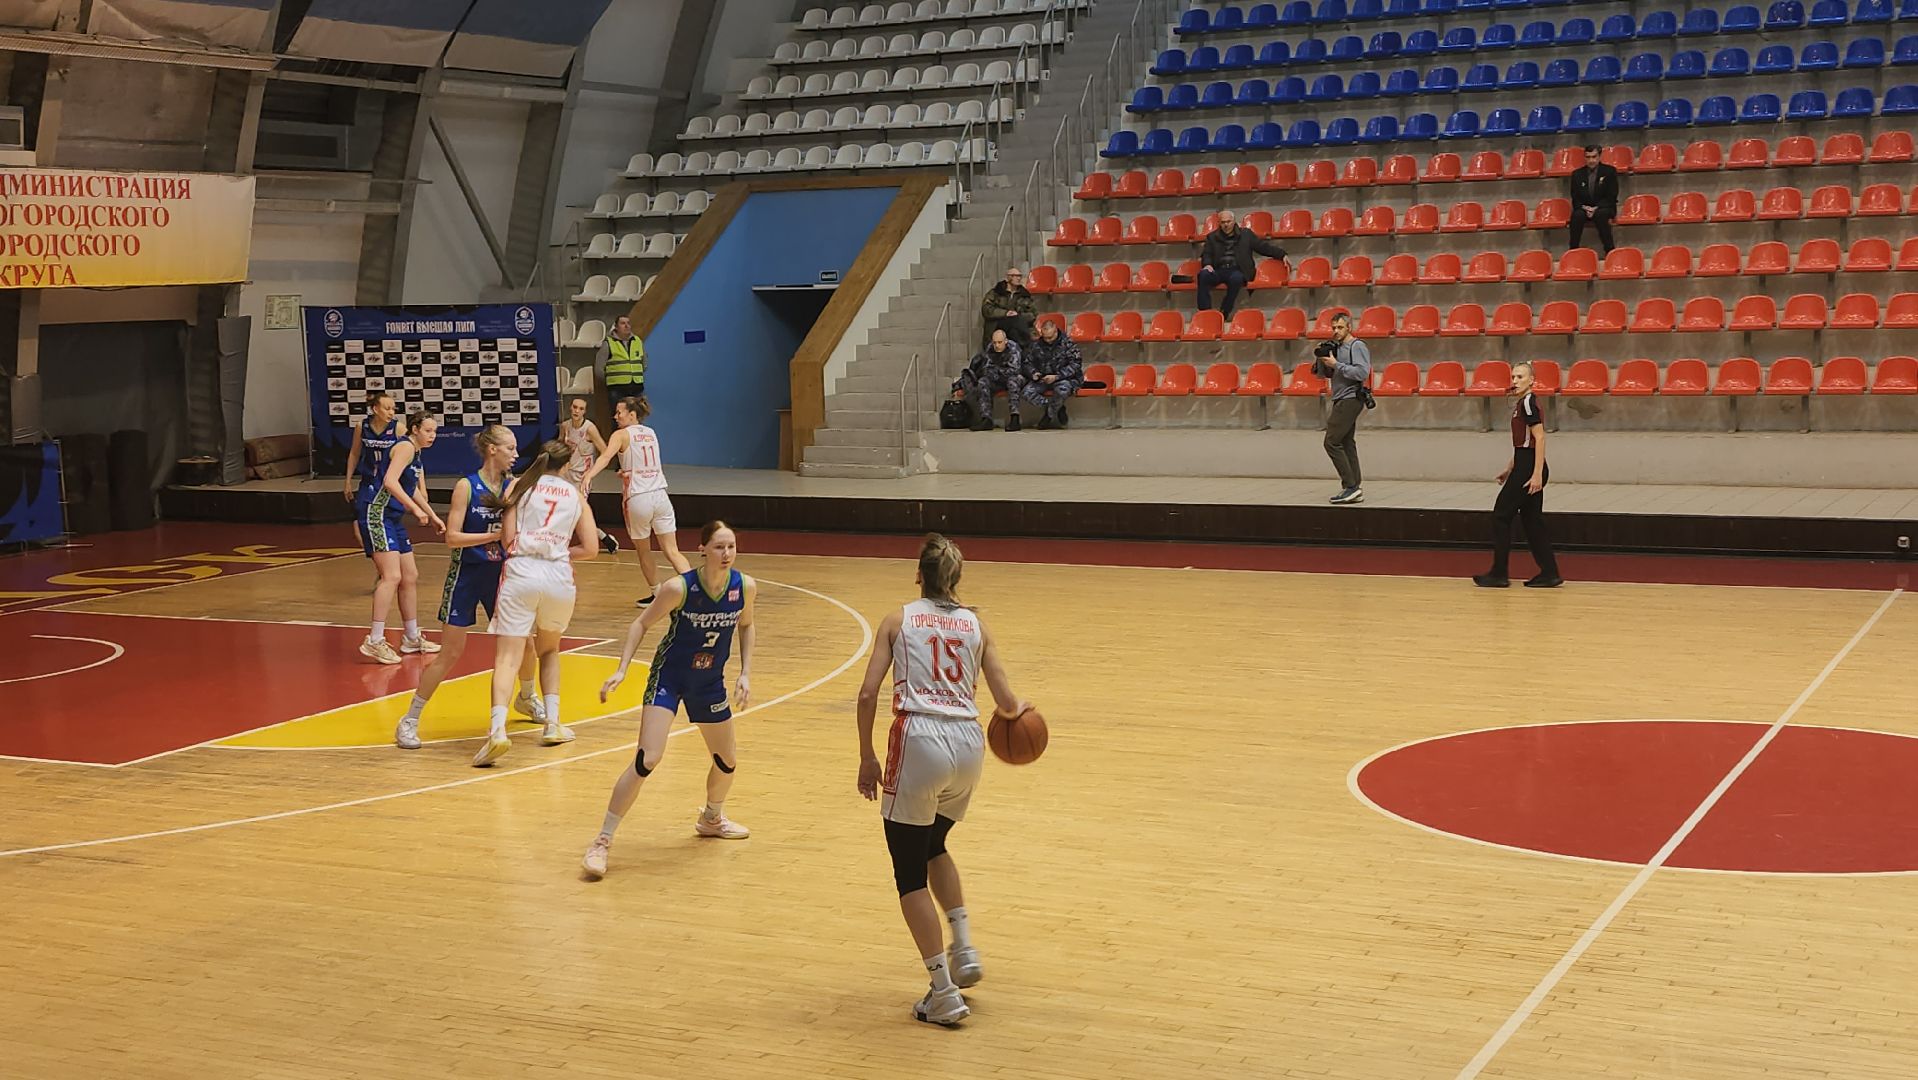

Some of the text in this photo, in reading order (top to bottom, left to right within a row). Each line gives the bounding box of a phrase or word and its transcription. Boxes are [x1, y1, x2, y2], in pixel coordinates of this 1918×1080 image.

[0, 233, 141, 261] РОДСКОГО
[641, 445, 656, 467] 11
[545, 500, 558, 527] 7
[702, 631, 721, 648] 3
[926, 634, 965, 684] 15
